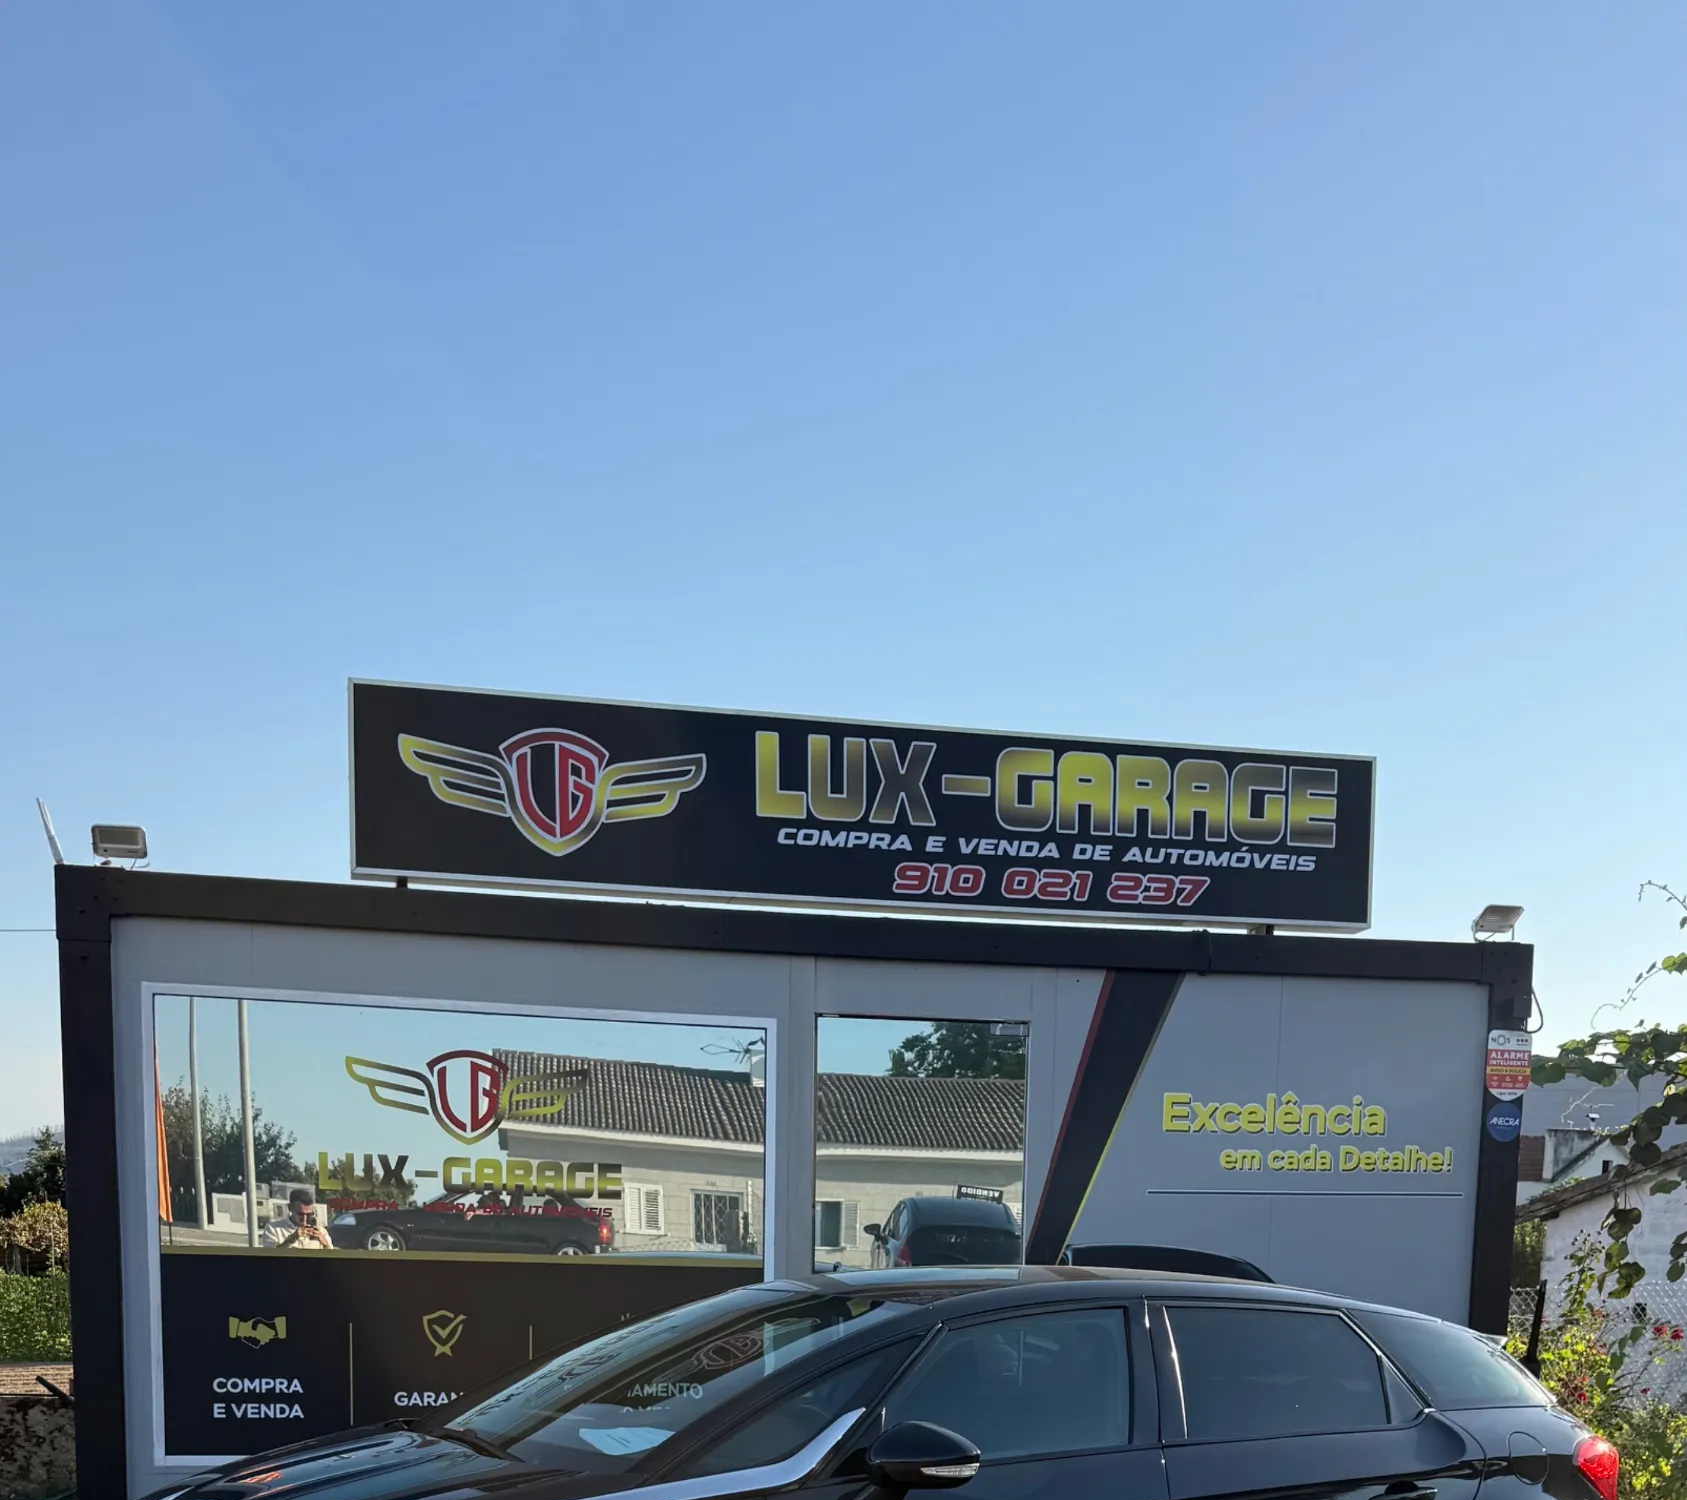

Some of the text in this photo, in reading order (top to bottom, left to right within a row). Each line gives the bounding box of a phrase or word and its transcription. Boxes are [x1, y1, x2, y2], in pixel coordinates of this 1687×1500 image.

[755, 731, 1338, 848] LUX-GARAGE
[777, 828, 1316, 872] COMPRA E VENDA DE AUTOMÓVEIS
[892, 862, 1210, 907] 910 021 237
[1490, 1051, 1529, 1060] ALARME
[1163, 1091, 1386, 1136] Excelência
[1489, 1117, 1520, 1126] ANECRA
[318, 1151, 622, 1199] LUX-GARAGE
[1220, 1144, 1453, 1173] em cada Detalhe!
[212, 1378, 304, 1393] COMPRA
[213, 1403, 305, 1418] E VENDA
